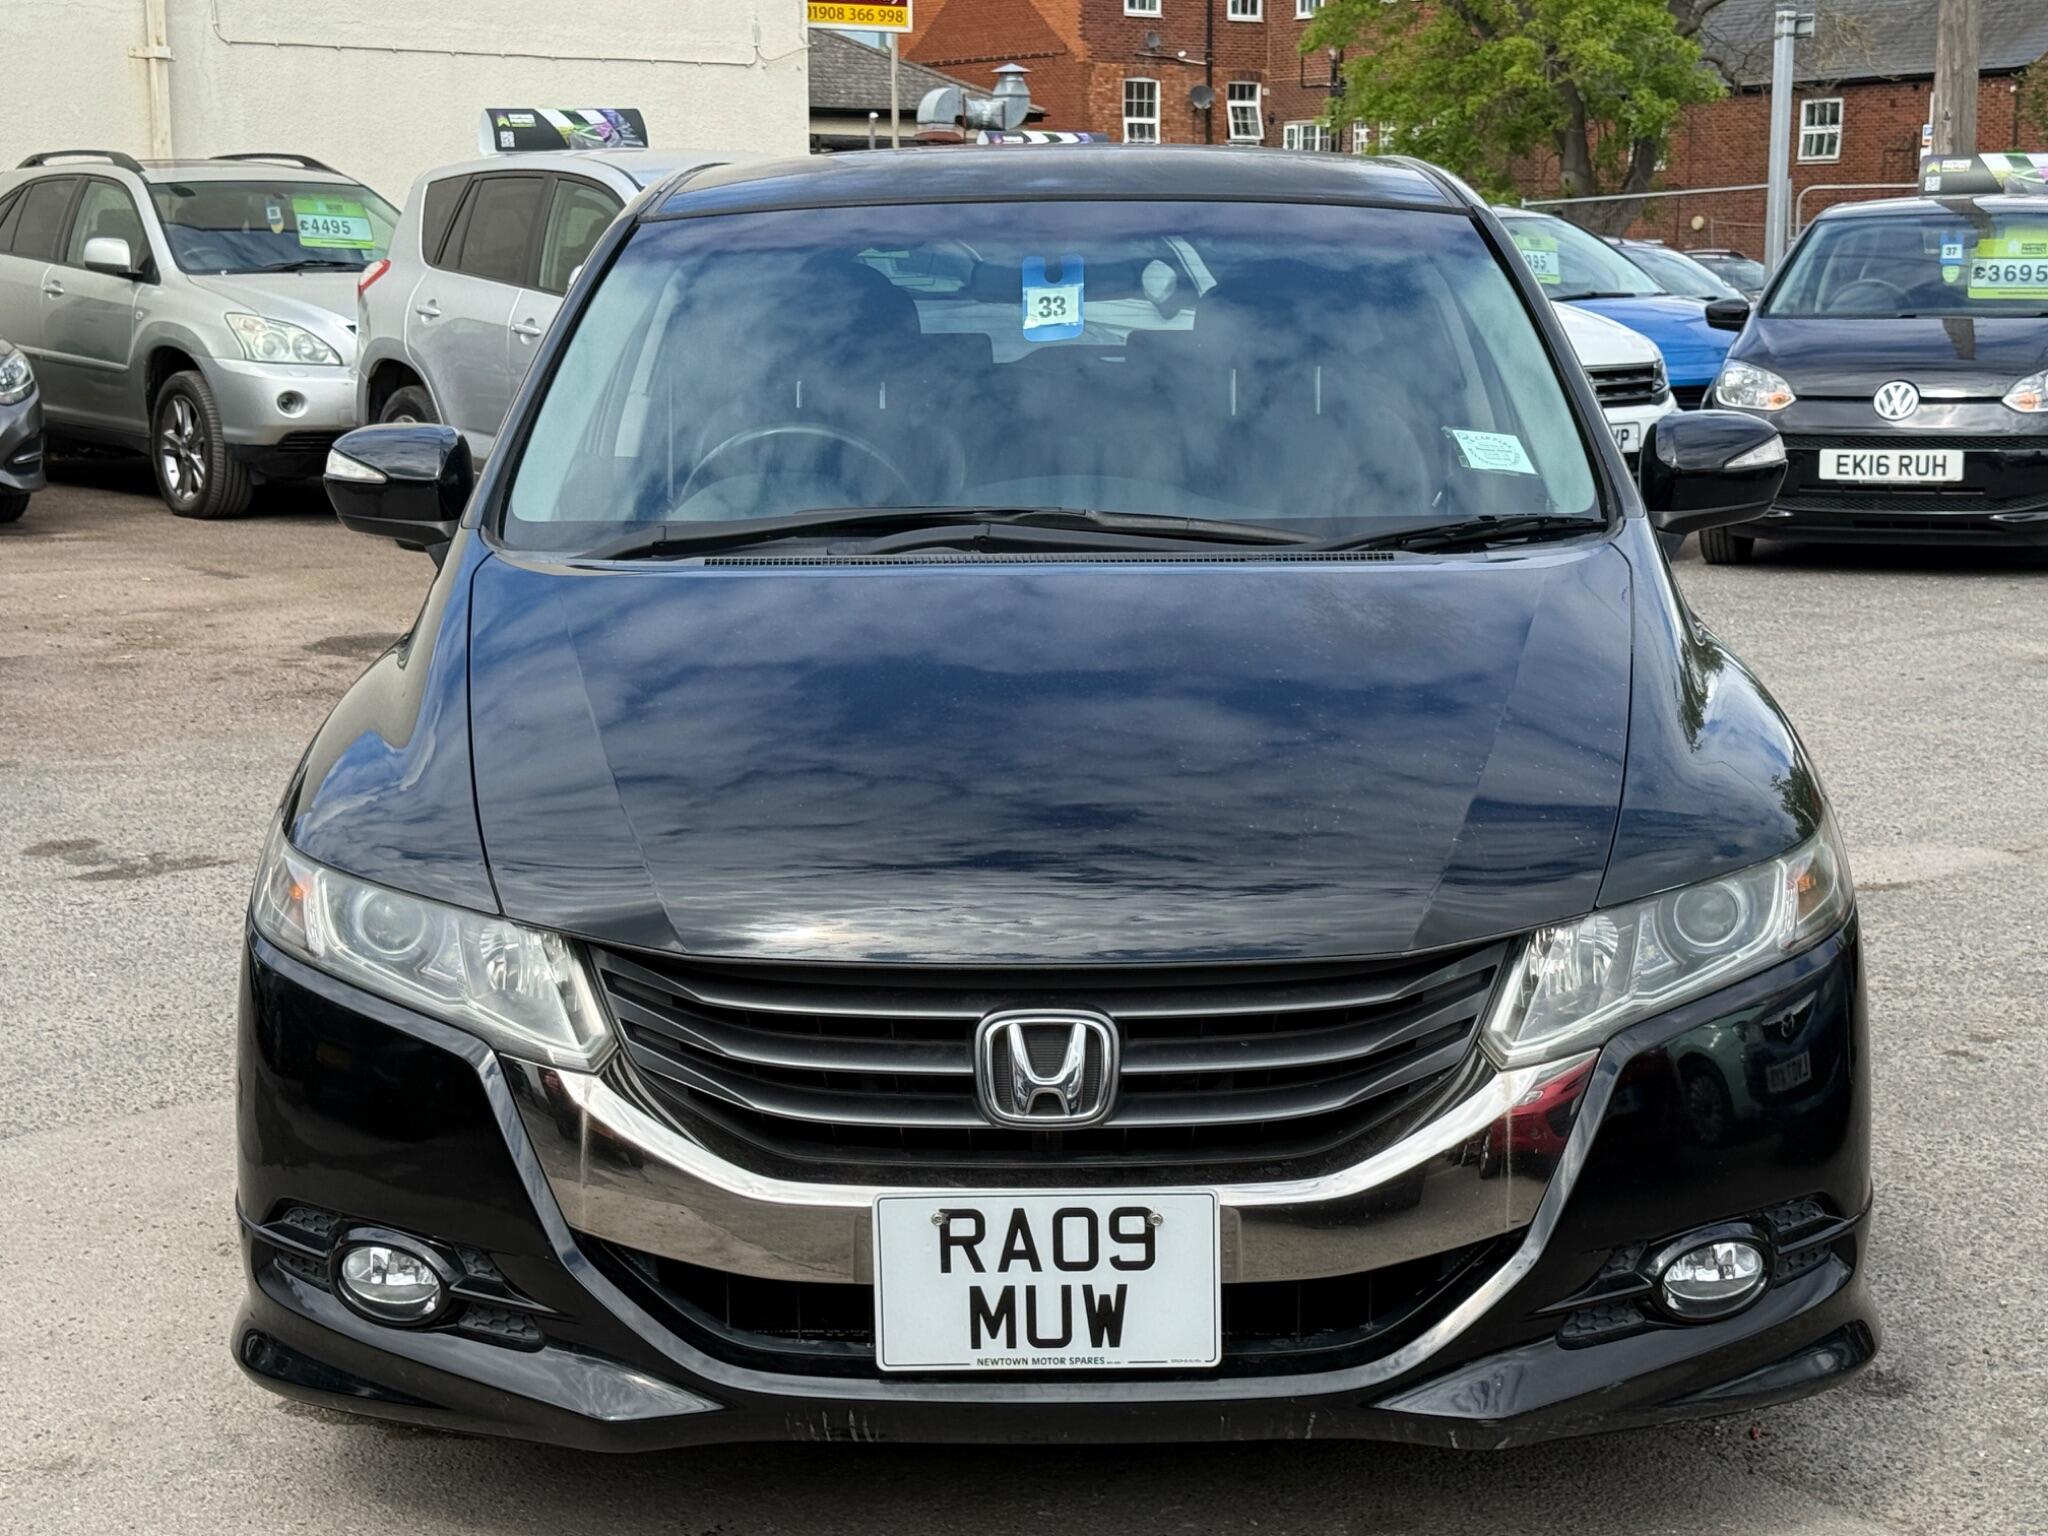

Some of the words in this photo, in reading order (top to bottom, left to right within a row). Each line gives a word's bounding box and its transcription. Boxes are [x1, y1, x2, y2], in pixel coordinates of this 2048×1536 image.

[848, 8, 875, 21] 366
[878, 9, 904, 23] 998
[1972, 264, 2048, 282] £3695
[1038, 295, 1067, 319] 33
[1836, 454, 1890, 476] EK16
[1898, 454, 1947, 477] RUH
[938, 1206, 1157, 1274] RA09
[968, 1283, 1129, 1350] MUW
[976, 1357, 1030, 1367] NEWTOWN
[1031, 1356, 1067, 1366] MOTOR
[1068, 1355, 1106, 1366] SPARES
